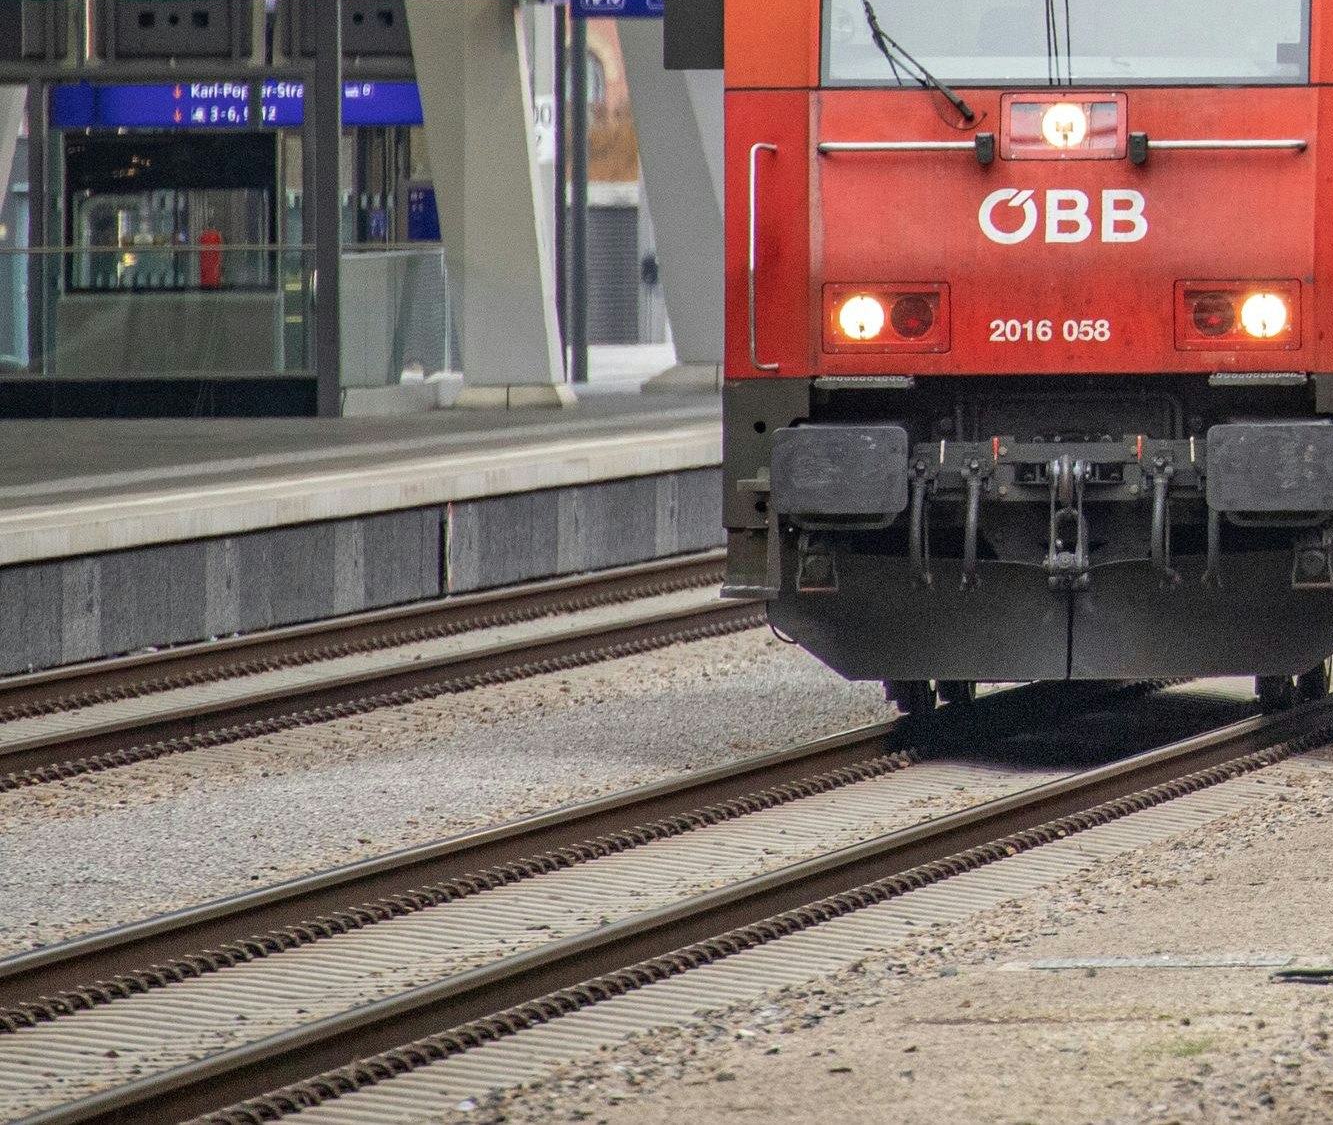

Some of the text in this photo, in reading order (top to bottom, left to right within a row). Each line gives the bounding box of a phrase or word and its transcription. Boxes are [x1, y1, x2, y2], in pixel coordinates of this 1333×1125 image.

[978, 187, 1148, 245] ÖBB
[989, 319, 1111, 342] 2016 058
